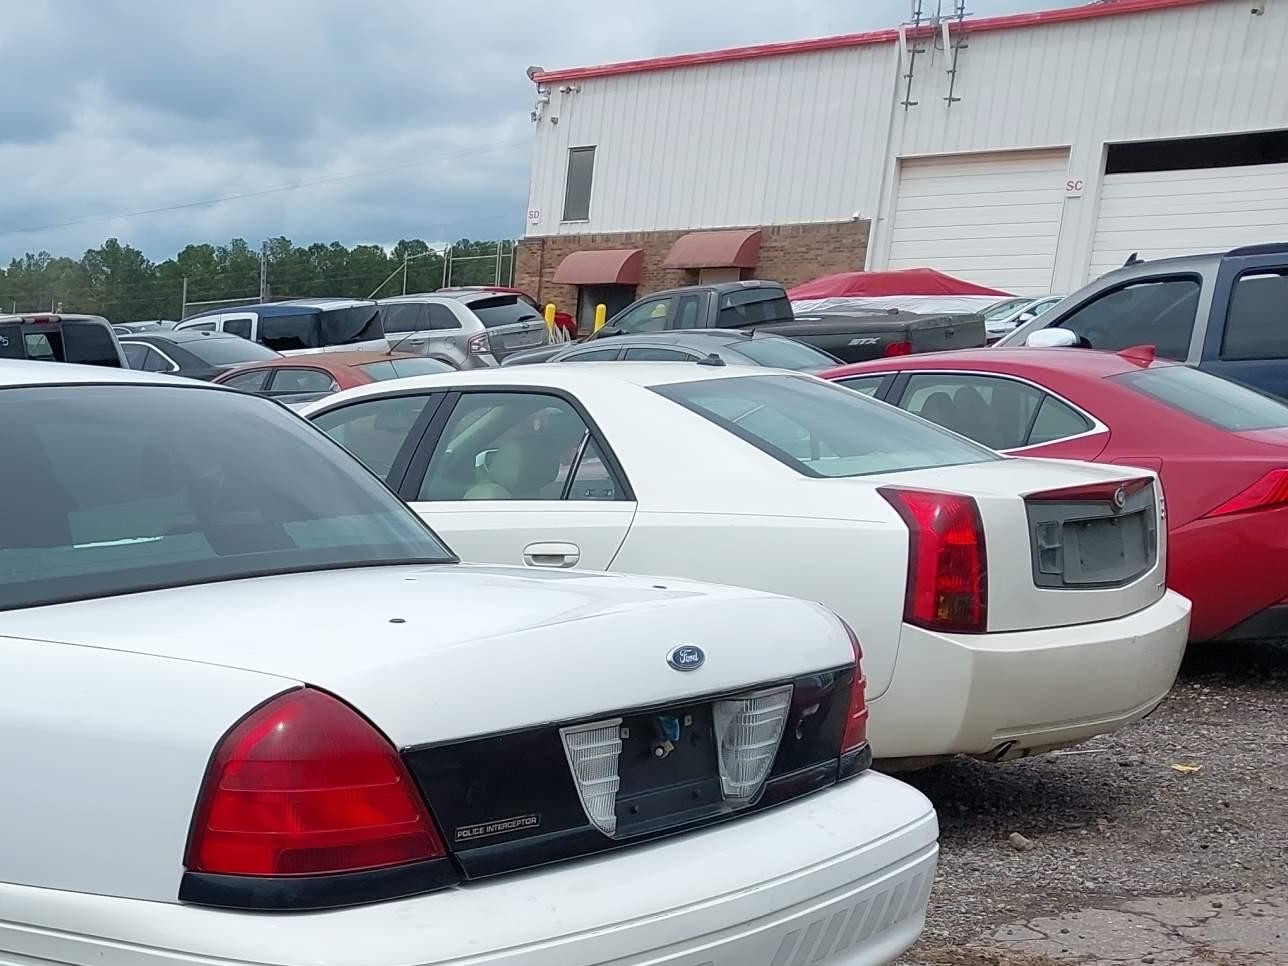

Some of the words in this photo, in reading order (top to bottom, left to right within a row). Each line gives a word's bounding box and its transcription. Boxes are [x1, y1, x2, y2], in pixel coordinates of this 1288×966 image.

[1066, 181, 1083, 191] SC
[528, 210, 540, 219] SD
[679, 649, 699, 663] Ford
[457, 827, 485, 838] POLICE
[486, 817, 537, 833] INTERCEPTOR
